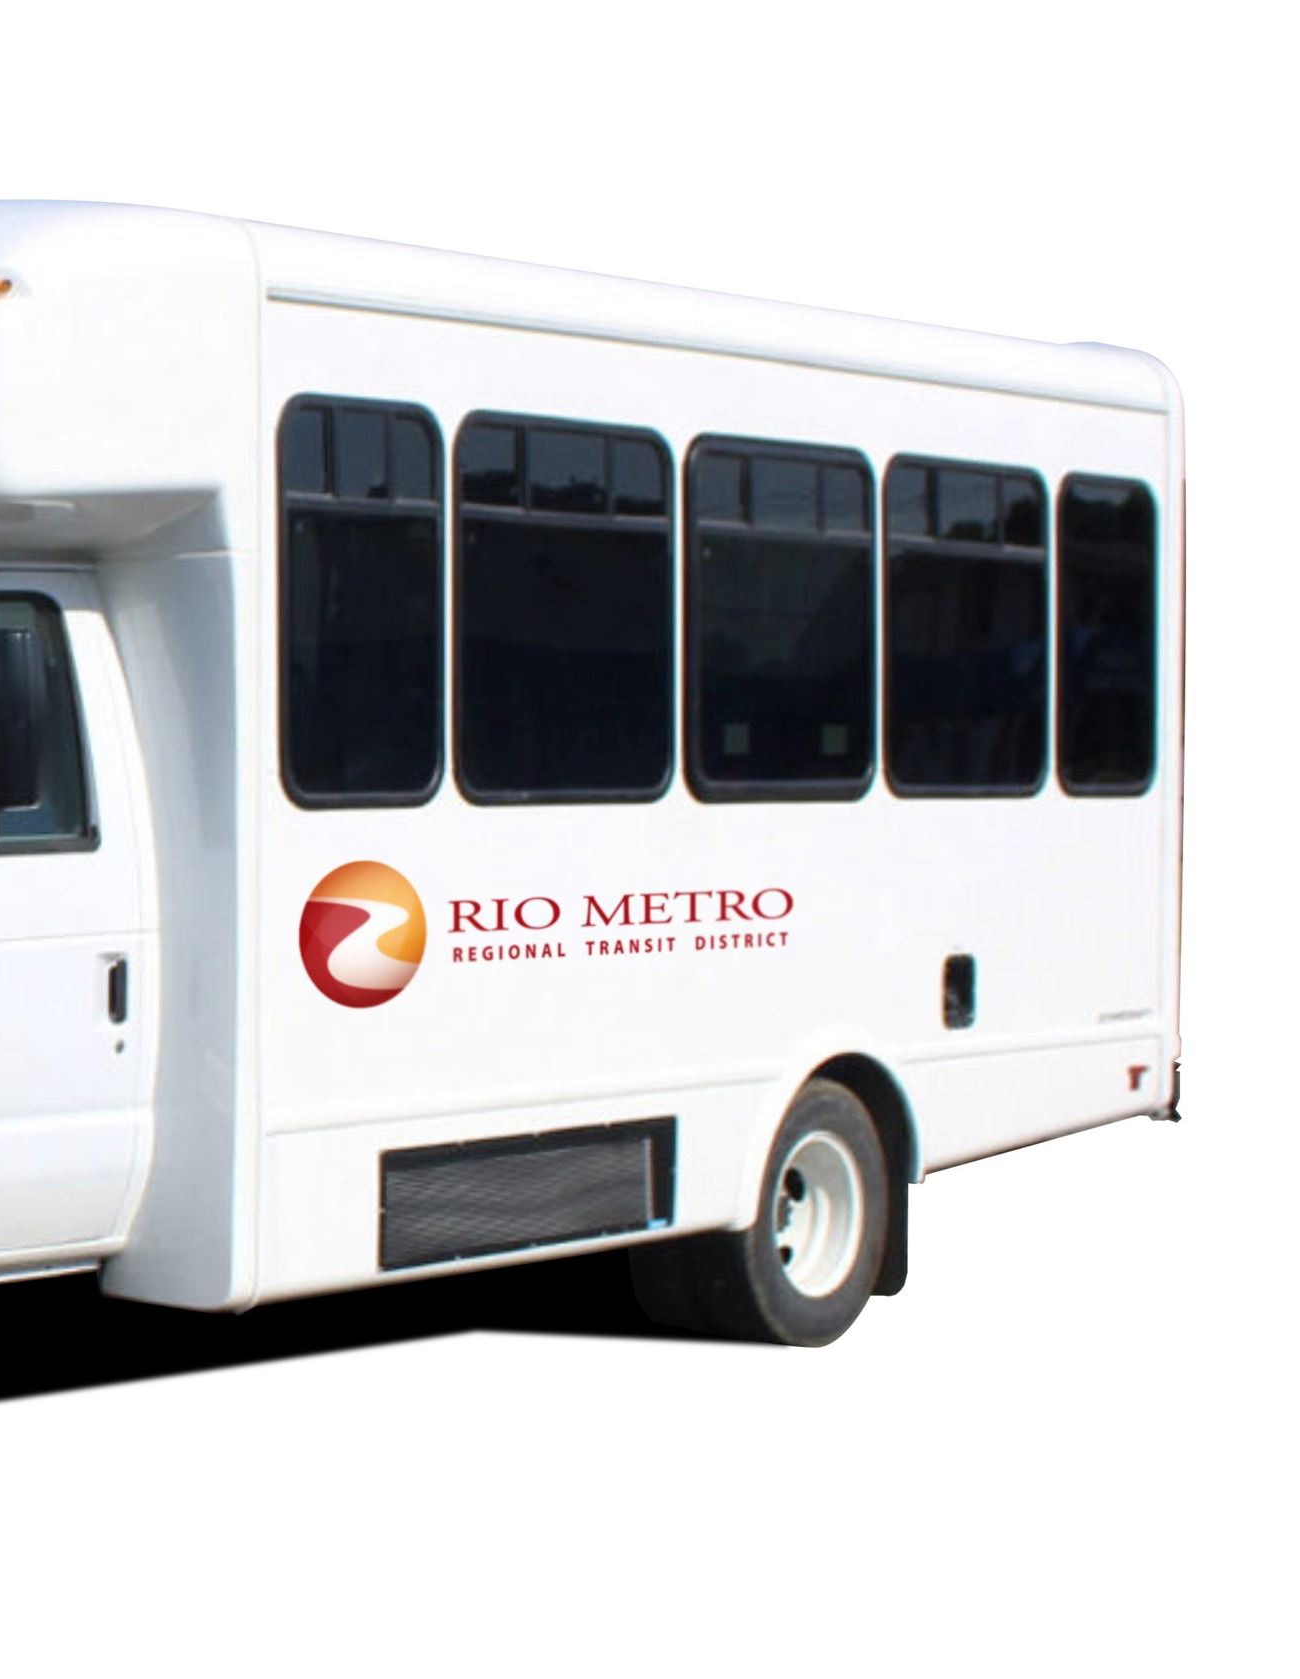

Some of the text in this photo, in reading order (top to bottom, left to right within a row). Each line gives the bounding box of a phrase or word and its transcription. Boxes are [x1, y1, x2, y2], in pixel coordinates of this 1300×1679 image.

[448, 888, 795, 933] RIO METRO
[452, 931, 789, 962] REGIONAL TRANSIT DISTRICT
